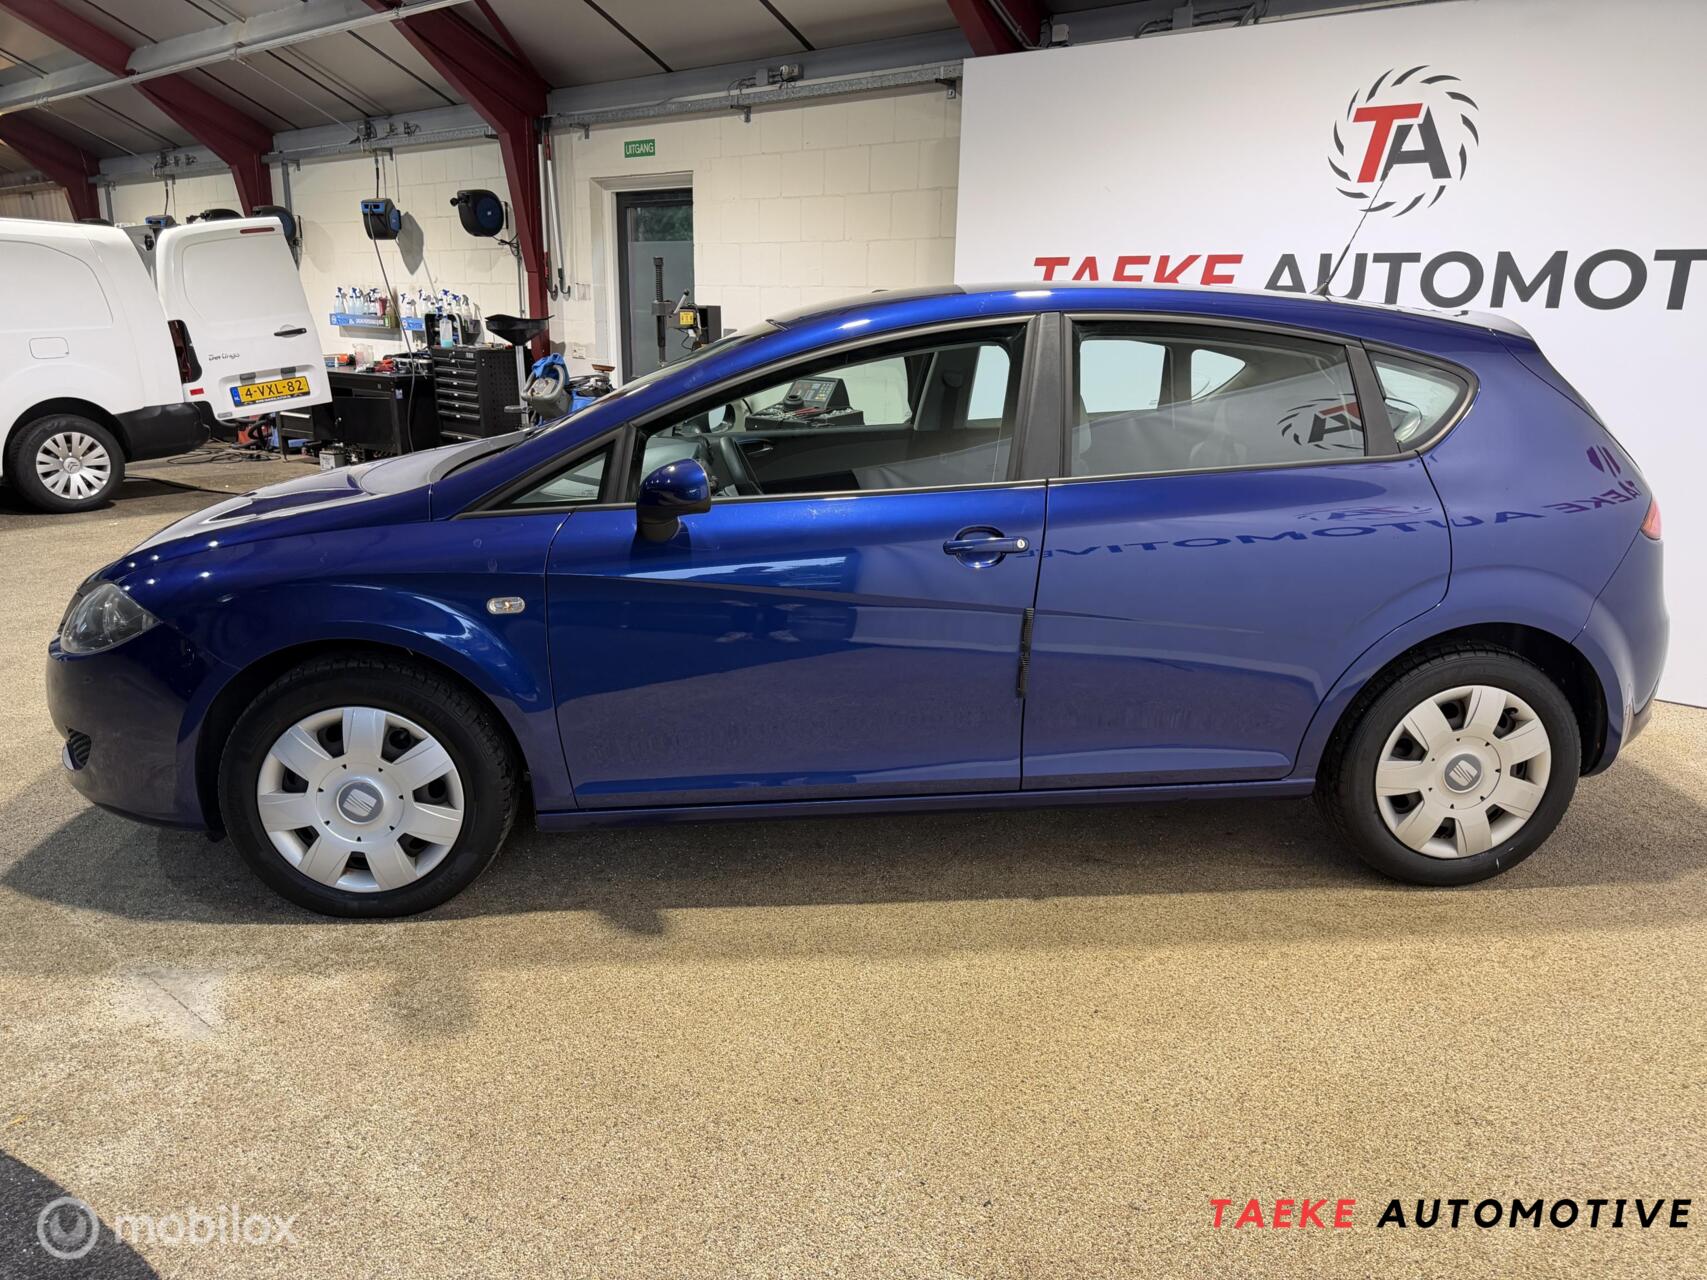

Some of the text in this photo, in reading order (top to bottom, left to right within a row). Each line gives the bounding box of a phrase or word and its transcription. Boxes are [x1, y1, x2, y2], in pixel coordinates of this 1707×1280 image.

[625, 142, 654, 155] UITGANG
[1353, 103, 1452, 183] TA
[245, 379, 304, 399] 4-VXL-82
